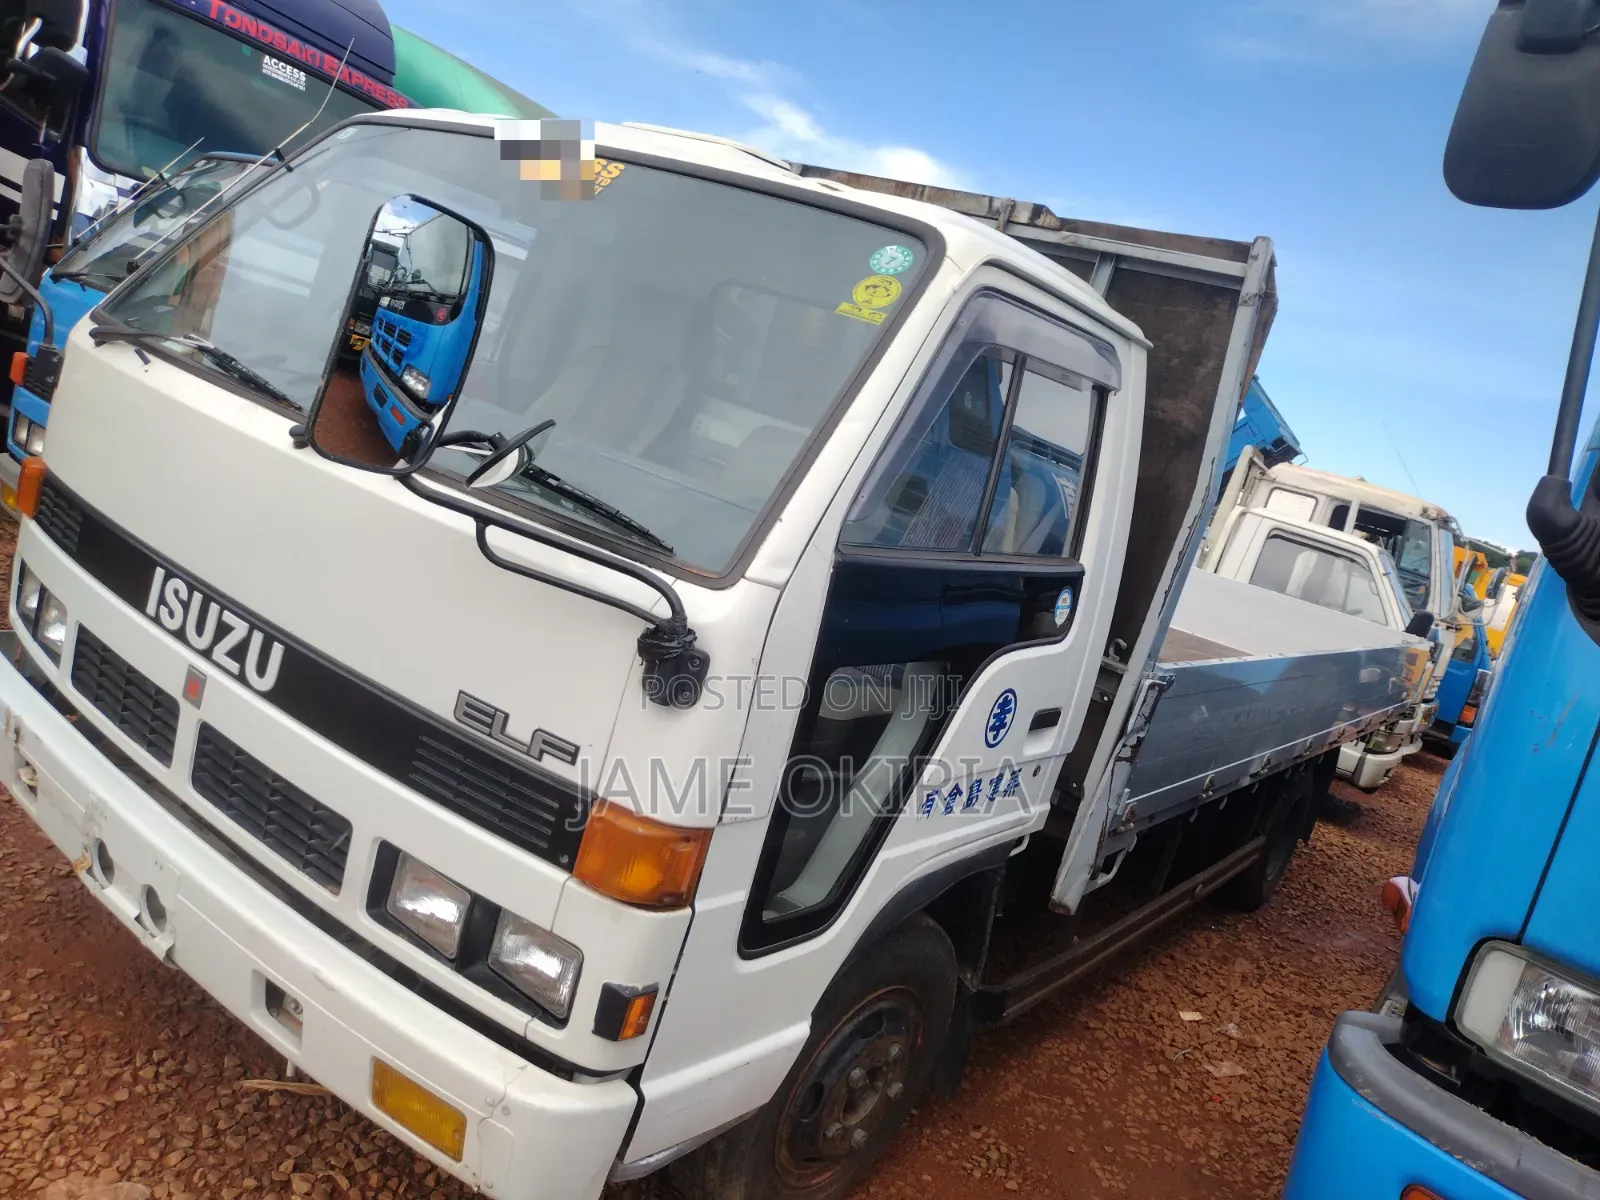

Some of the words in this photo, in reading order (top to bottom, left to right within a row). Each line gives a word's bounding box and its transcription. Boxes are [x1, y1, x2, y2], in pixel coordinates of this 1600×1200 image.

[208, 0, 320, 68] TONOSAKI
[323, 53, 409, 110] EXPRESS
[263, 55, 306, 82] ACCESS
[146, 566, 285, 692] ISUZU
[453, 689, 580, 766] ELF
